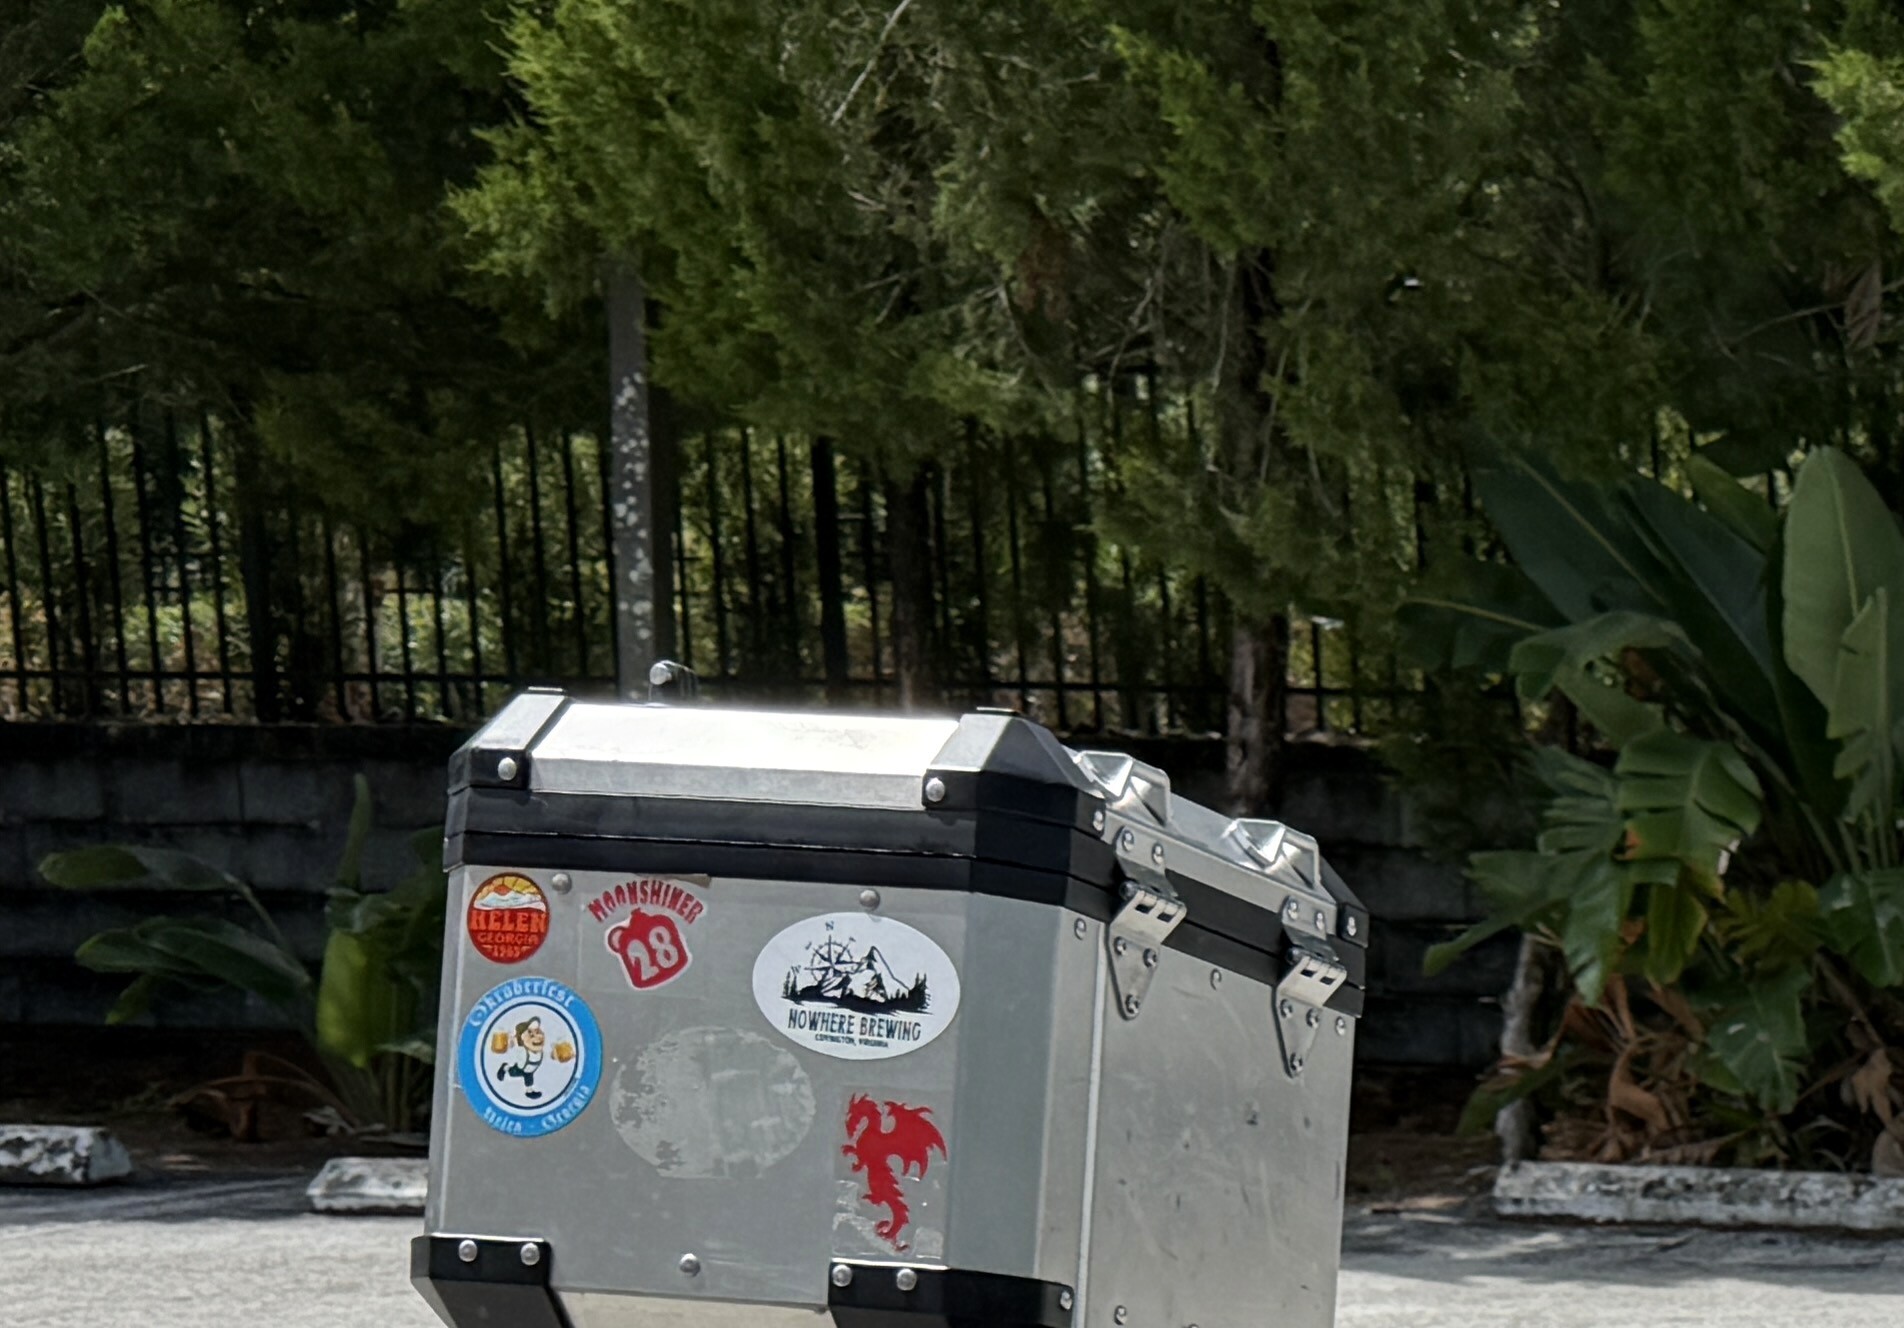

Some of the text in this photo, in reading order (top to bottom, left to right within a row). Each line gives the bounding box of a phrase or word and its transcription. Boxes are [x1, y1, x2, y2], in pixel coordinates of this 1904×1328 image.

[588, 879, 704, 924] MOONSHINER
[470, 910, 548, 933] HELEN
[627, 925, 679, 981] 28
[787, 1008, 921, 1042] NOWHERE BREWING
